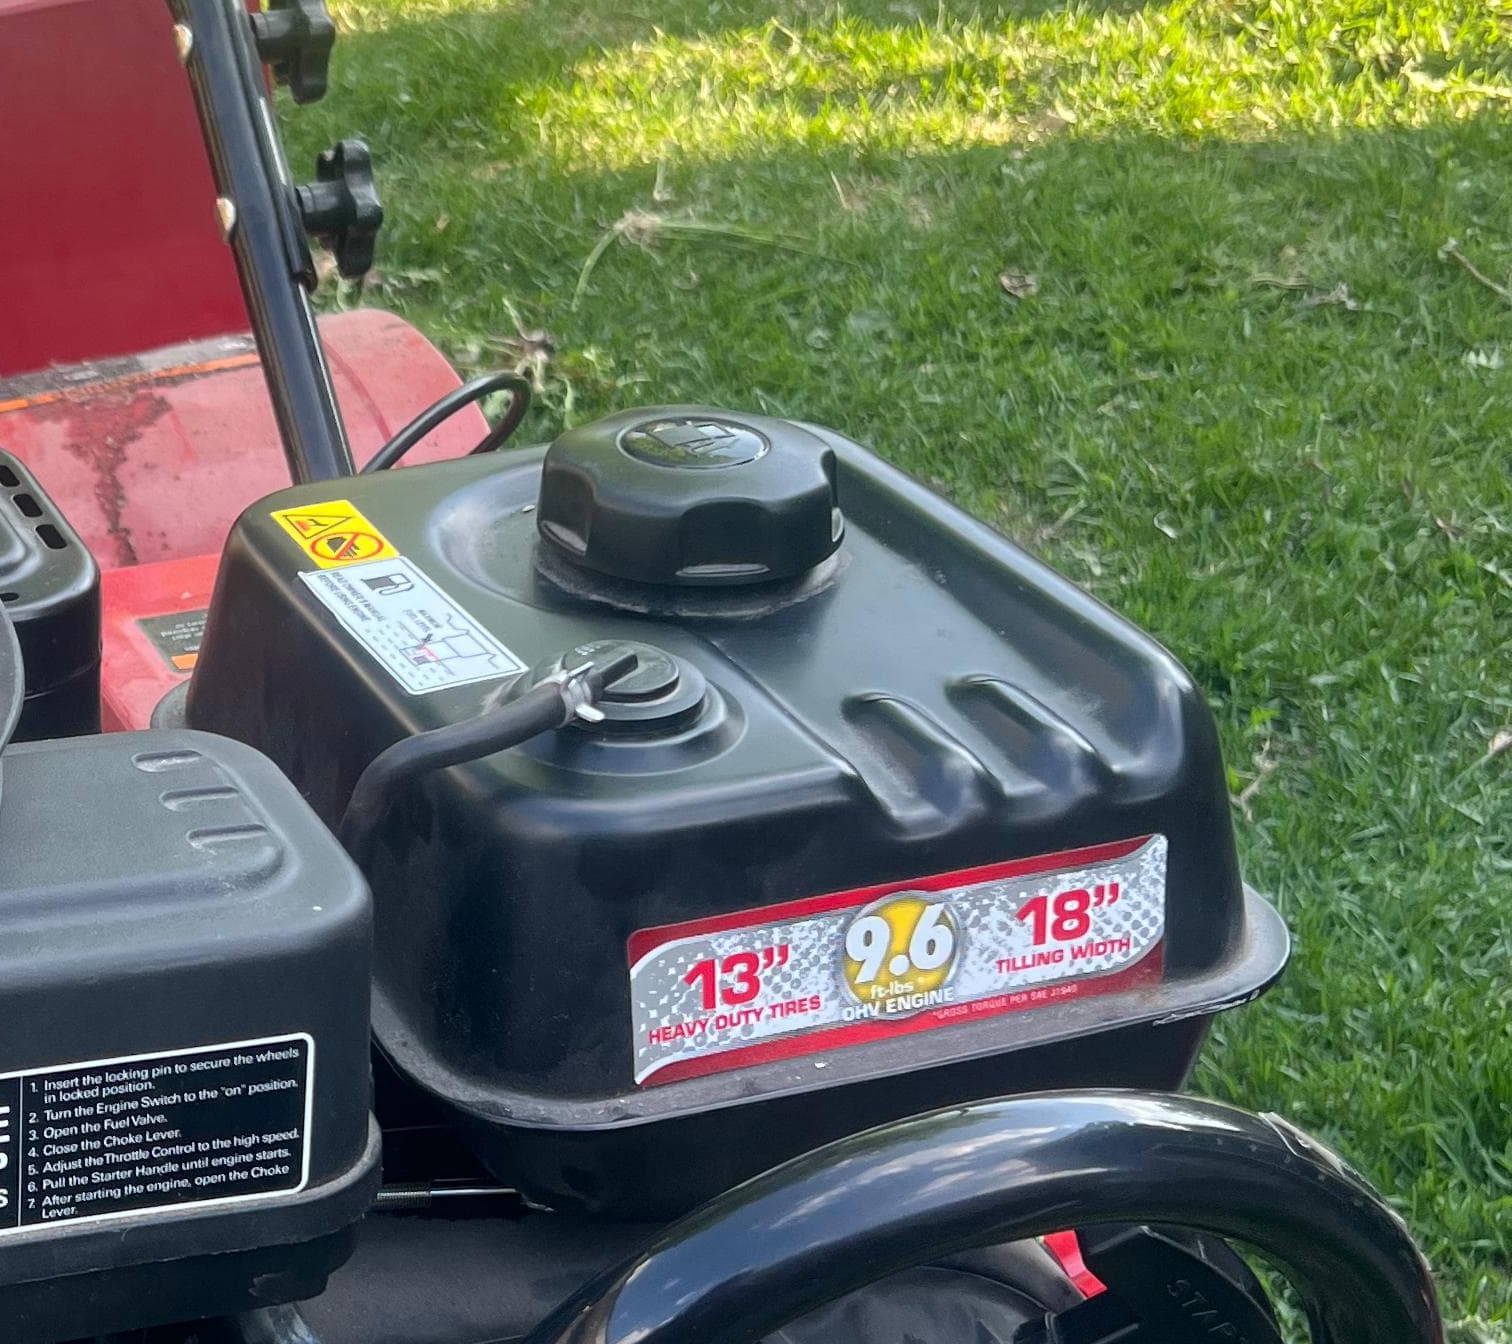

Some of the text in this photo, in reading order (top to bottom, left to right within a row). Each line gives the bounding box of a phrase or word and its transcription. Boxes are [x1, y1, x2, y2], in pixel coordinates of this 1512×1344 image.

[845, 902, 954, 984] 9.6
[995, 936, 1131, 974] TILLING WIDTH
[648, 994, 821, 1045] HEAVY DUTY TIRES
[842, 987, 954, 1022] OHV ENGINE
[29, 1047, 300, 1093] 1. Insert the locking pin to secure the wheels
[28, 1112, 40, 1124] 2.
[43, 1108, 72, 1122] Turn
[74, 1104, 94, 1117] the
[96, 1099, 140, 1115] Engine
[140, 1093, 182, 1109] Switch
[183, 1092, 197, 1103] to
[198, 1088, 219, 1100] the
[248, 1078, 299, 1096] position.
[44, 1080, 156, 1104] in locked position.
[28, 1113, 168, 1141] 3. Open the Fuel Valve.
[28, 1129, 182, 1158] 4. Close the Choke Lever.
[28, 1127, 299, 1176] 5. Adjust the Throttle Control to the high speed.
[28, 1147, 291, 1193] 6. Pull the Starter Handle until engine starts.
[41, 1194, 73, 1207] After
[74, 1187, 122, 1203] starting
[124, 1183, 145, 1196] the
[194, 1172, 226, 1187] open
[228, 1169, 249, 1182] the
[250, 1164, 290, 1178] Choke
[41, 1206, 79, 1219] Lever.
